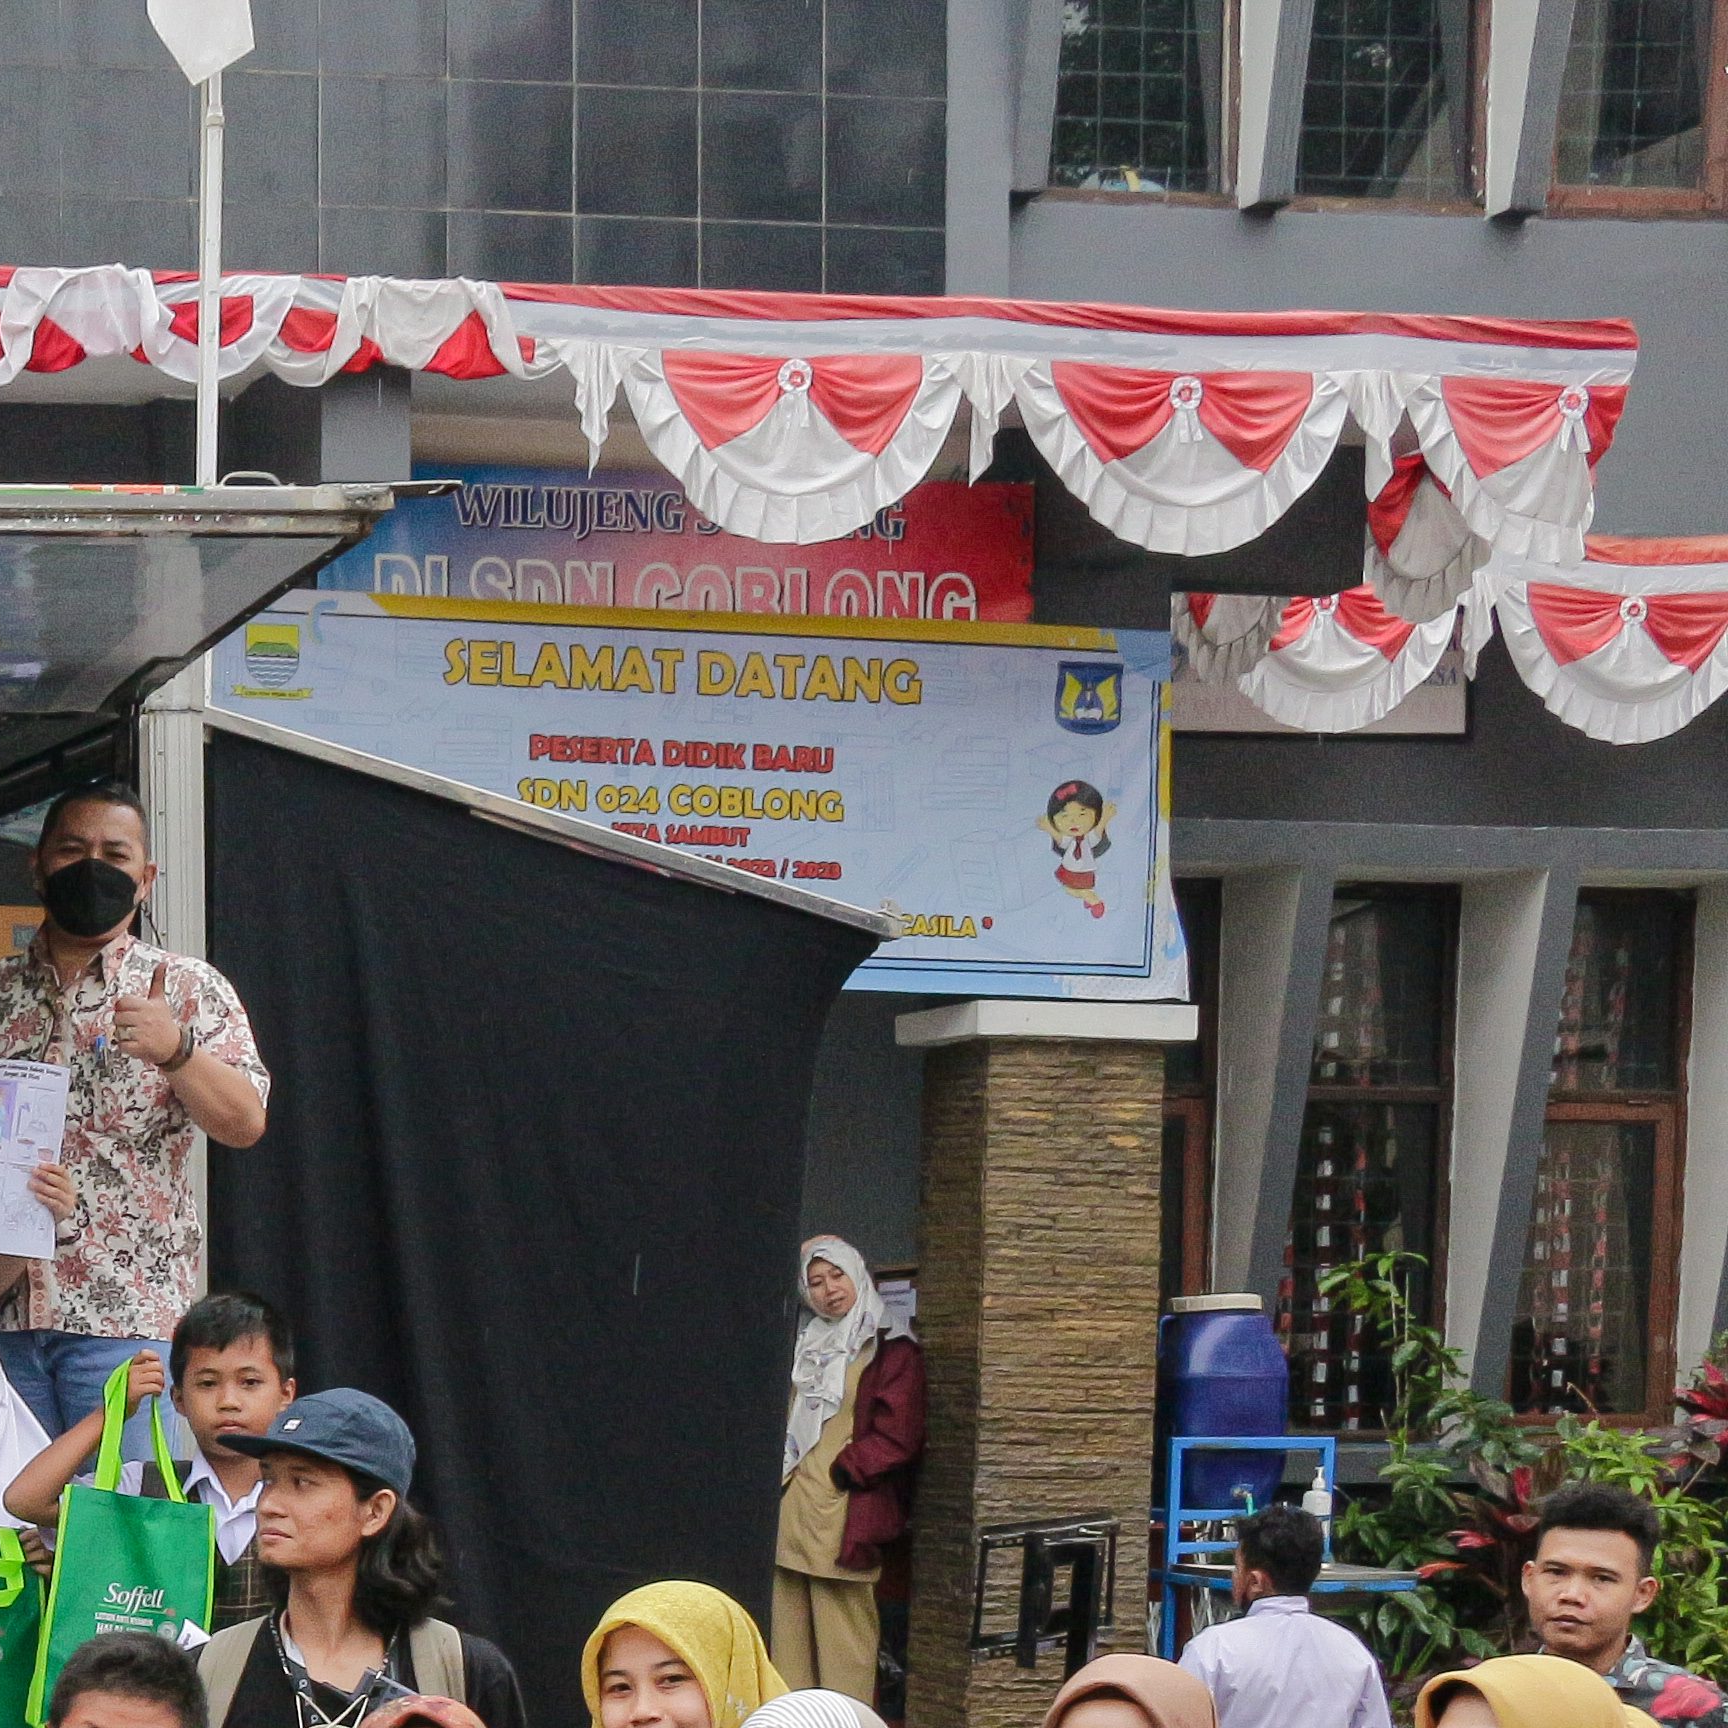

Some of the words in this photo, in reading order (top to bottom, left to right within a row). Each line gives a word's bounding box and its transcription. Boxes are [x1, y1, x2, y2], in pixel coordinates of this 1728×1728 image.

[455, 484, 684, 541] WILUJENG
[443, 639, 684, 695] SELAMAT
[697, 649, 923, 705] DATANG
[529, 734, 655, 768] PESERTA
[662, 738, 745, 770] DIDIK
[750, 742, 835, 774] BARU
[518, 778, 588, 813] SDN
[596, 787, 660, 817] 024
[668, 781, 845, 823] COBLONG
[666, 826, 751, 848] SAMBUT
[103, 1582, 165, 1614] Soffell
